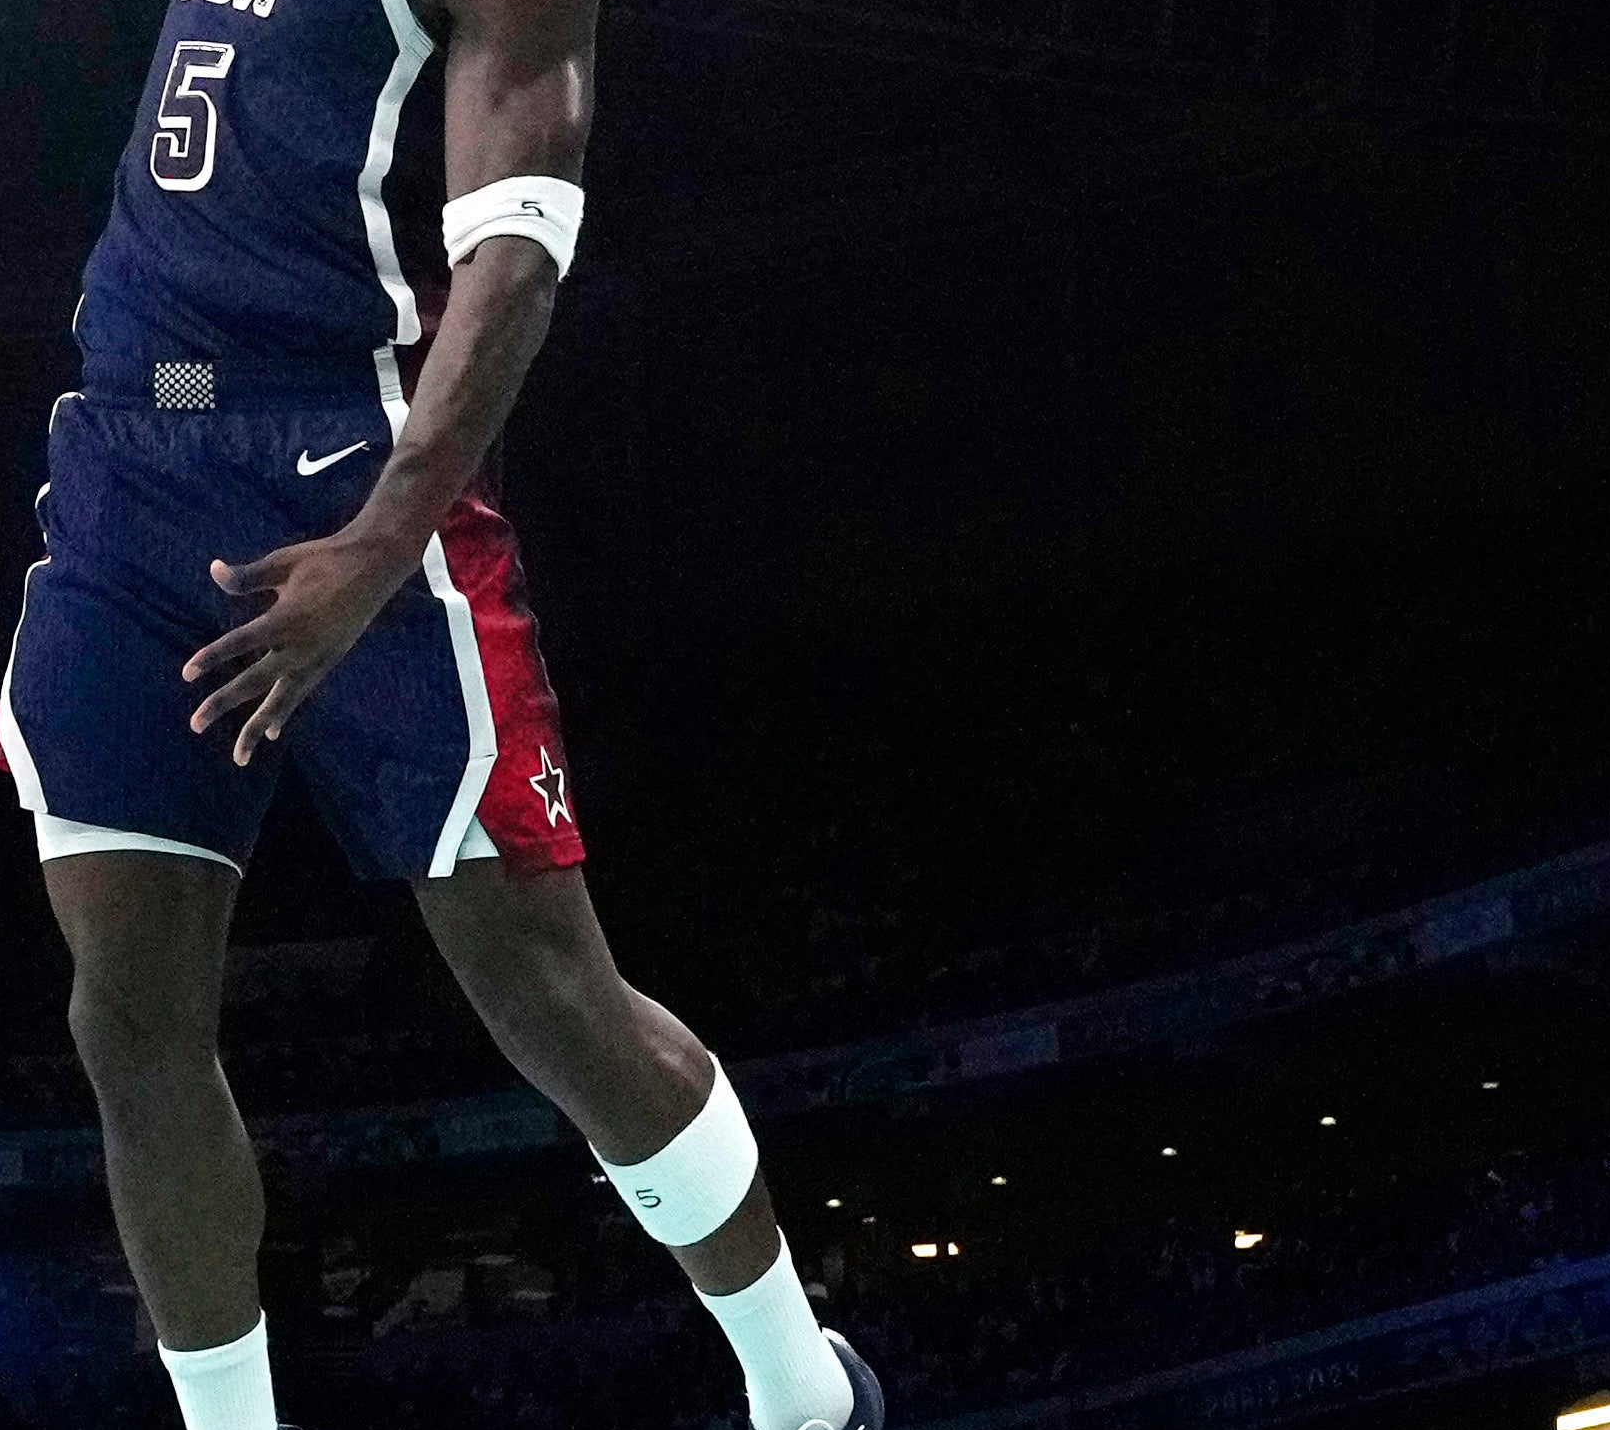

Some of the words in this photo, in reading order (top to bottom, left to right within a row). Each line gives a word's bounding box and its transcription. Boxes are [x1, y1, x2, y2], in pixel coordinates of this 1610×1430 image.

[149, 39, 235, 192] 5
[522, 201, 544, 218] 5
[635, 1188, 662, 1210] 5
